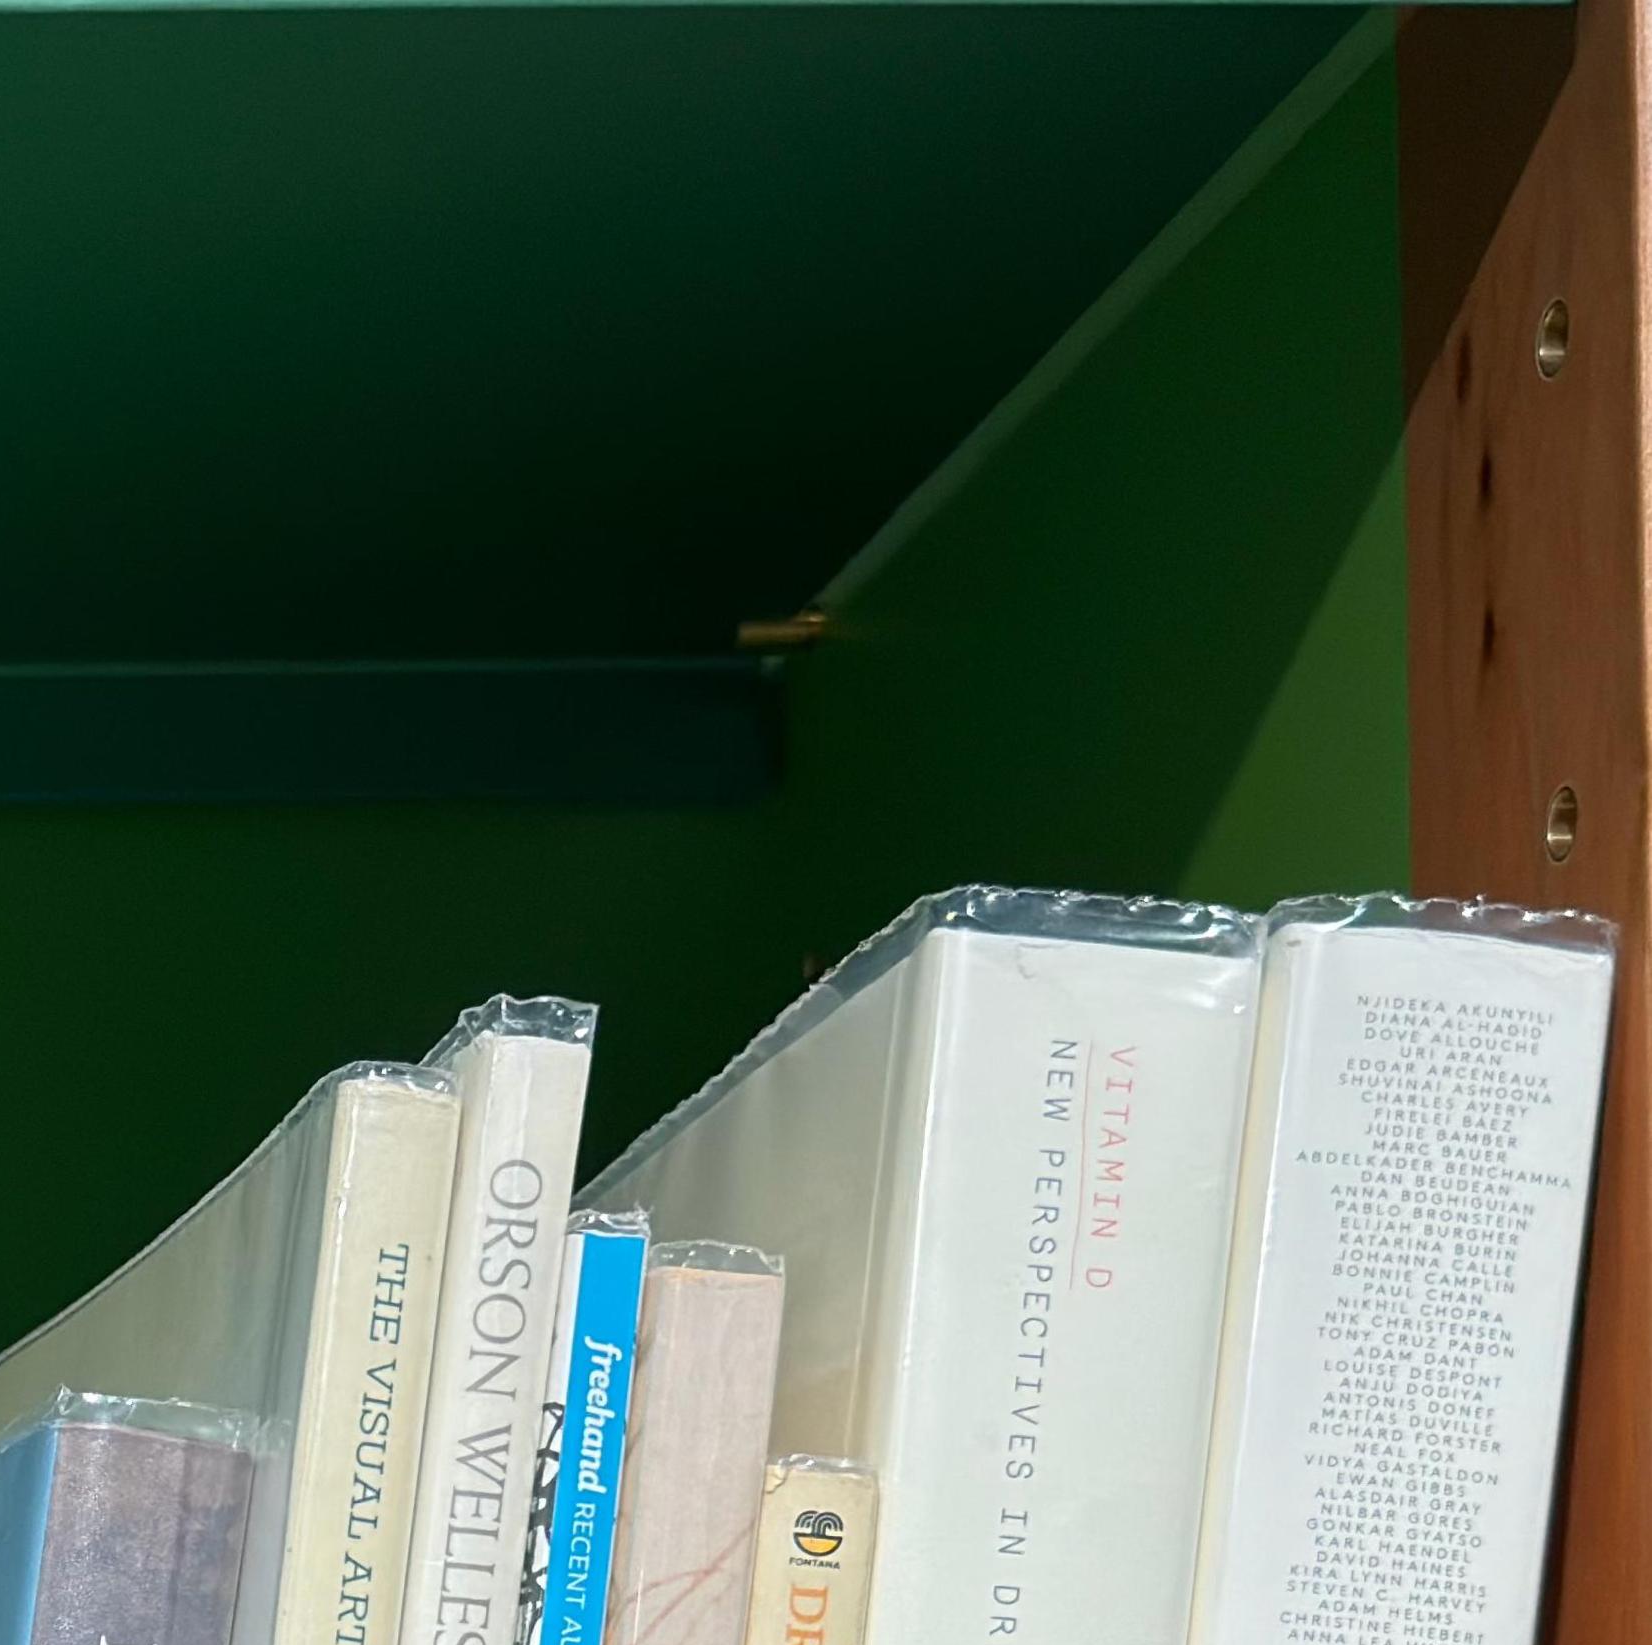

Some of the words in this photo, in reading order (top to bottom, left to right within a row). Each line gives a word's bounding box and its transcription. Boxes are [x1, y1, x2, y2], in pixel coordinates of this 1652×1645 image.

[1356, 995, 1445, 1012] NJIDEKA
[1456, 1003, 1553, 1024] AKUNYILI
[1364, 1010, 1430, 1027] DIANA
[1363, 1026, 1419, 1043] DOVE
[1429, 1033, 1539, 1055] ALLOUCHE
[1399, 1045, 1434, 1059] URI
[1445, 1050, 1502, 1066] ARAN
[1041, 1038, 1077, 1124] NEW
[1338, 1072, 1441, 1091] SHUVINAI
[1451, 1083, 1552, 1104] ASHOONA
[1360, 1090, 1454, 1110] CHARLES
[1465, 1100, 1529, 1117] AVERY
[1088, 1043, 1137, 1242] VITAMIN
[1365, 1122, 1425, 1140] JUDIE
[1436, 1128, 1518, 1148] BAMBER
[1297, 1150, 1433, 1171] ABDELKADER
[1444, 1161, 1571, 1188] BENCHAMMA
[1360, 1170, 1402, 1184] DAN
[1414, 1174, 1511, 1195] BEUDEAN
[1330, 1184, 1388, 1199] ANNA
[1400, 1189, 1535, 1215] BOGHIGUIAN
[1334, 1199, 1401, 1217] PABLO
[1412, 1207, 1528, 1230] BRONSTEIN
[369, 1242, 410, 1344] THE
[466, 1157, 544, 1402] ORSON
[1085, 1266, 1114, 1292] D
[1331, 1263, 1412, 1282] BONNIE
[1423, 1271, 1515, 1293] CAMPLIN
[1002, 1145, 1069, 1482] PERSPECTIVES
[1324, 1311, 1359, 1325] NIK
[1370, 1314, 1512, 1341] CHRISTENSEN
[577, 1334, 623, 1495] freehand
[349, 1358, 399, 1541] VISUAL
[1308, 1421, 1403, 1441] RICHARD
[1414, 1431, 1501, 1453] FORSTER
[1314, 1487, 1418, 1507] ALASDAIR
[1428, 1497, 1481, 1515] GRAY
[996, 1507, 1032, 1559] IN
[1305, 1517, 1394, 1536] GONKAR
[1405, 1527, 1482, 1548] GYATSO
[565, 1502, 595, 1610] RECENT
[788, 1556, 841, 1570] FONTANA
[1279, 1610, 1392, 1634] CHRISTINE
[1402, 1625, 1484, 1644] HIEBERT
